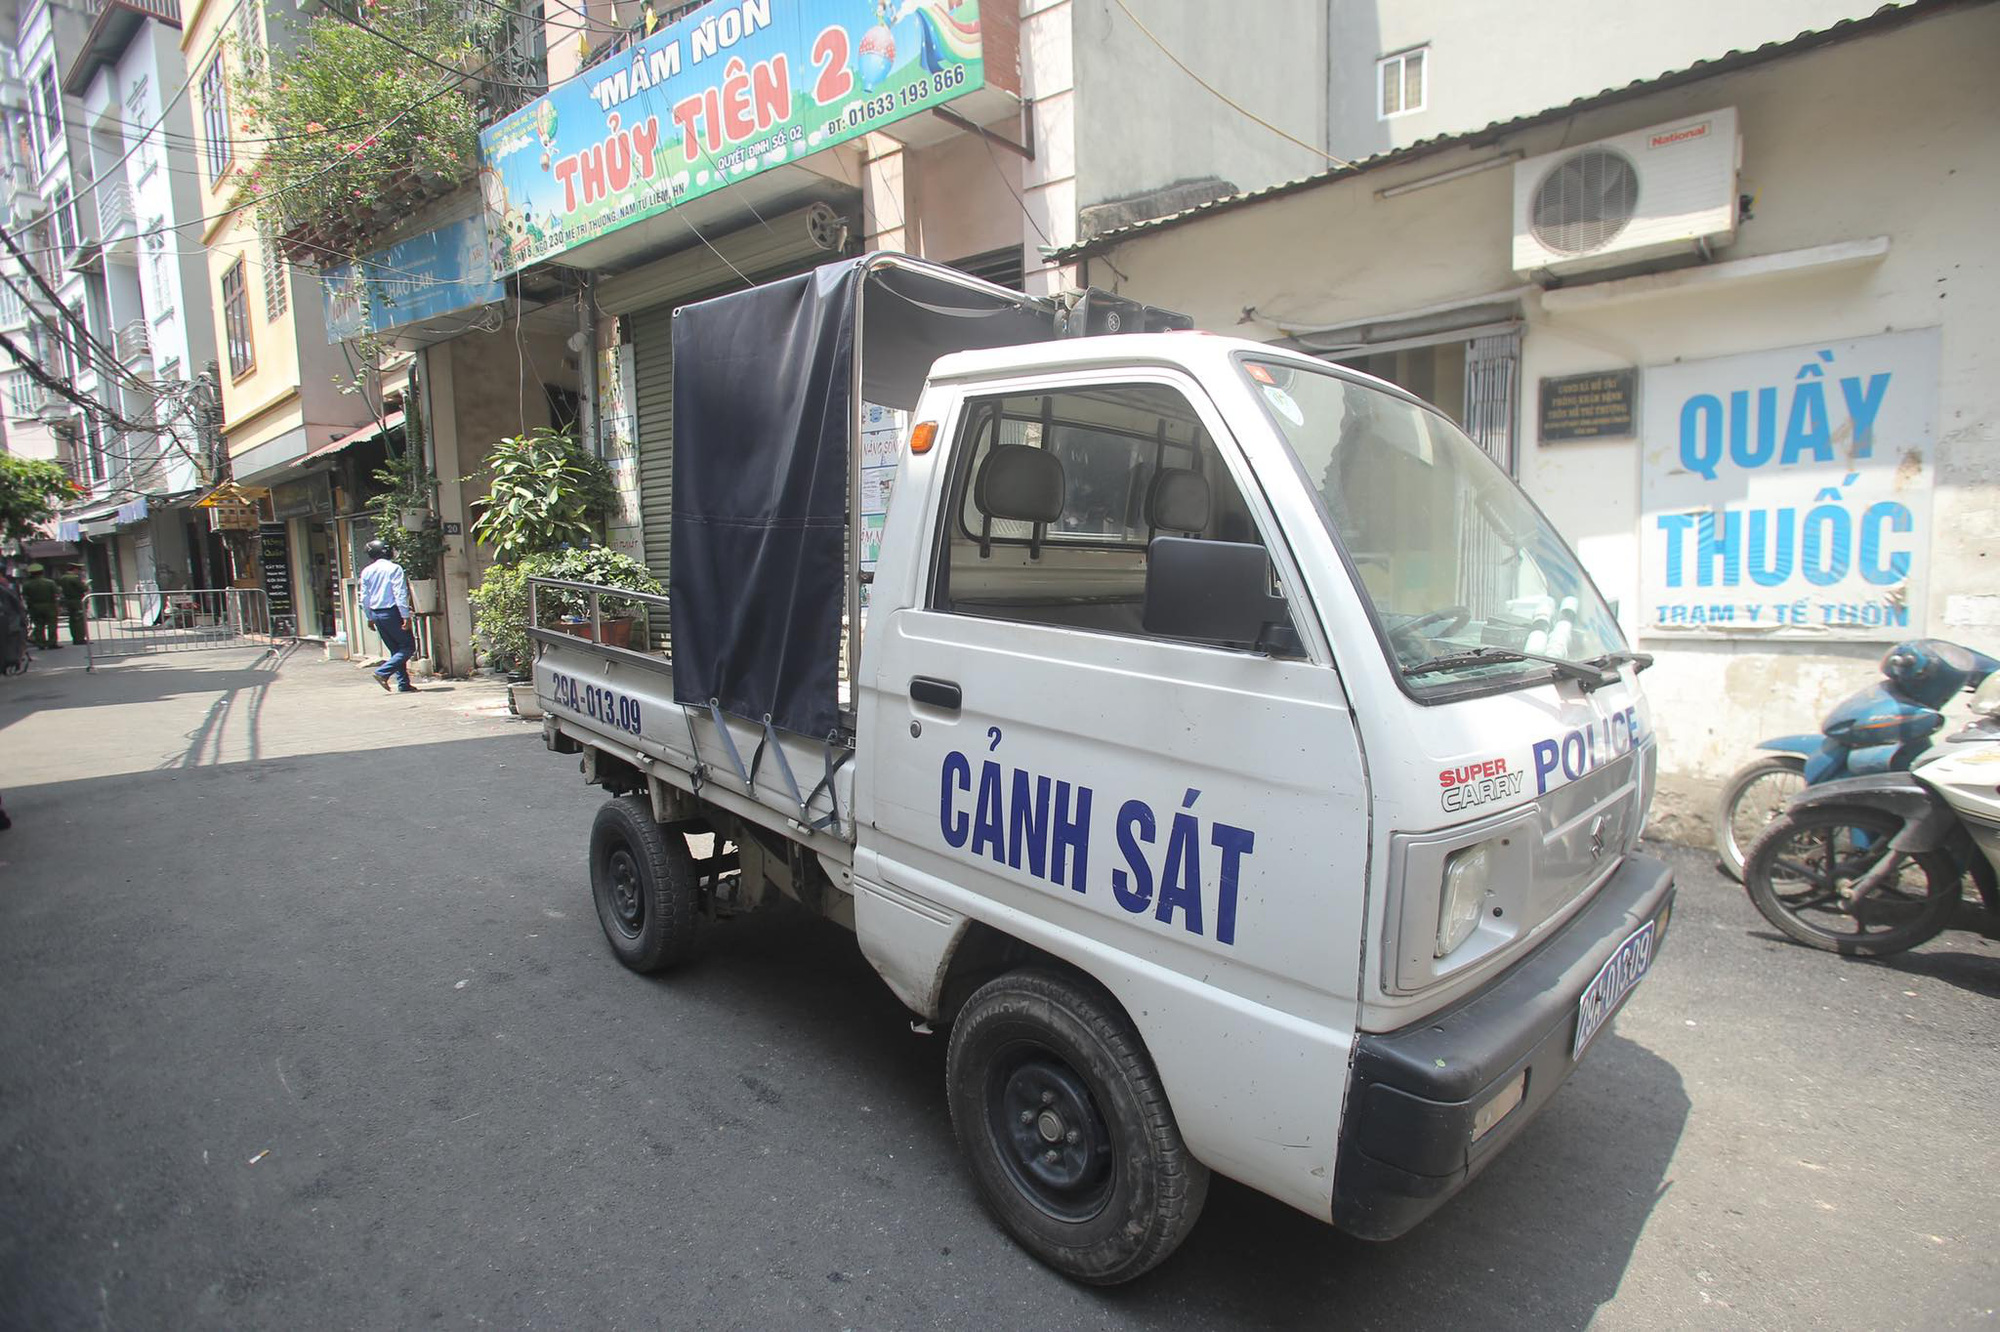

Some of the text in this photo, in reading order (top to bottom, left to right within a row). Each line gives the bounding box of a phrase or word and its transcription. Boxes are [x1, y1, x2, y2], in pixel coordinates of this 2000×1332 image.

[555, 112, 658, 213] THỦY
[673, 56, 791, 162] TIÊN
[812, 25, 853, 106] 2
[828, 64, 964, 135] ĐT: 01633 193 866
[789, 125, 803, 141] 02
[1652, 125, 1706, 147] National
[549, 230, 564, 248] 230
[620, 203, 637, 219] NAM
[672, 182, 685, 197] HN
[1679, 349, 1892, 480] QUẦY
[1657, 473, 1914, 588] THUỐC
[1746, 604, 1762, 623] Y
[552, 672, 642, 735] 29A-013.09
[1439, 758, 1508, 788] SUPER
[1532, 706, 1640, 797] POLICE
[1441, 770, 1524, 813] CARRY
[940, 726, 1256, 946] CẢNH SÁT
